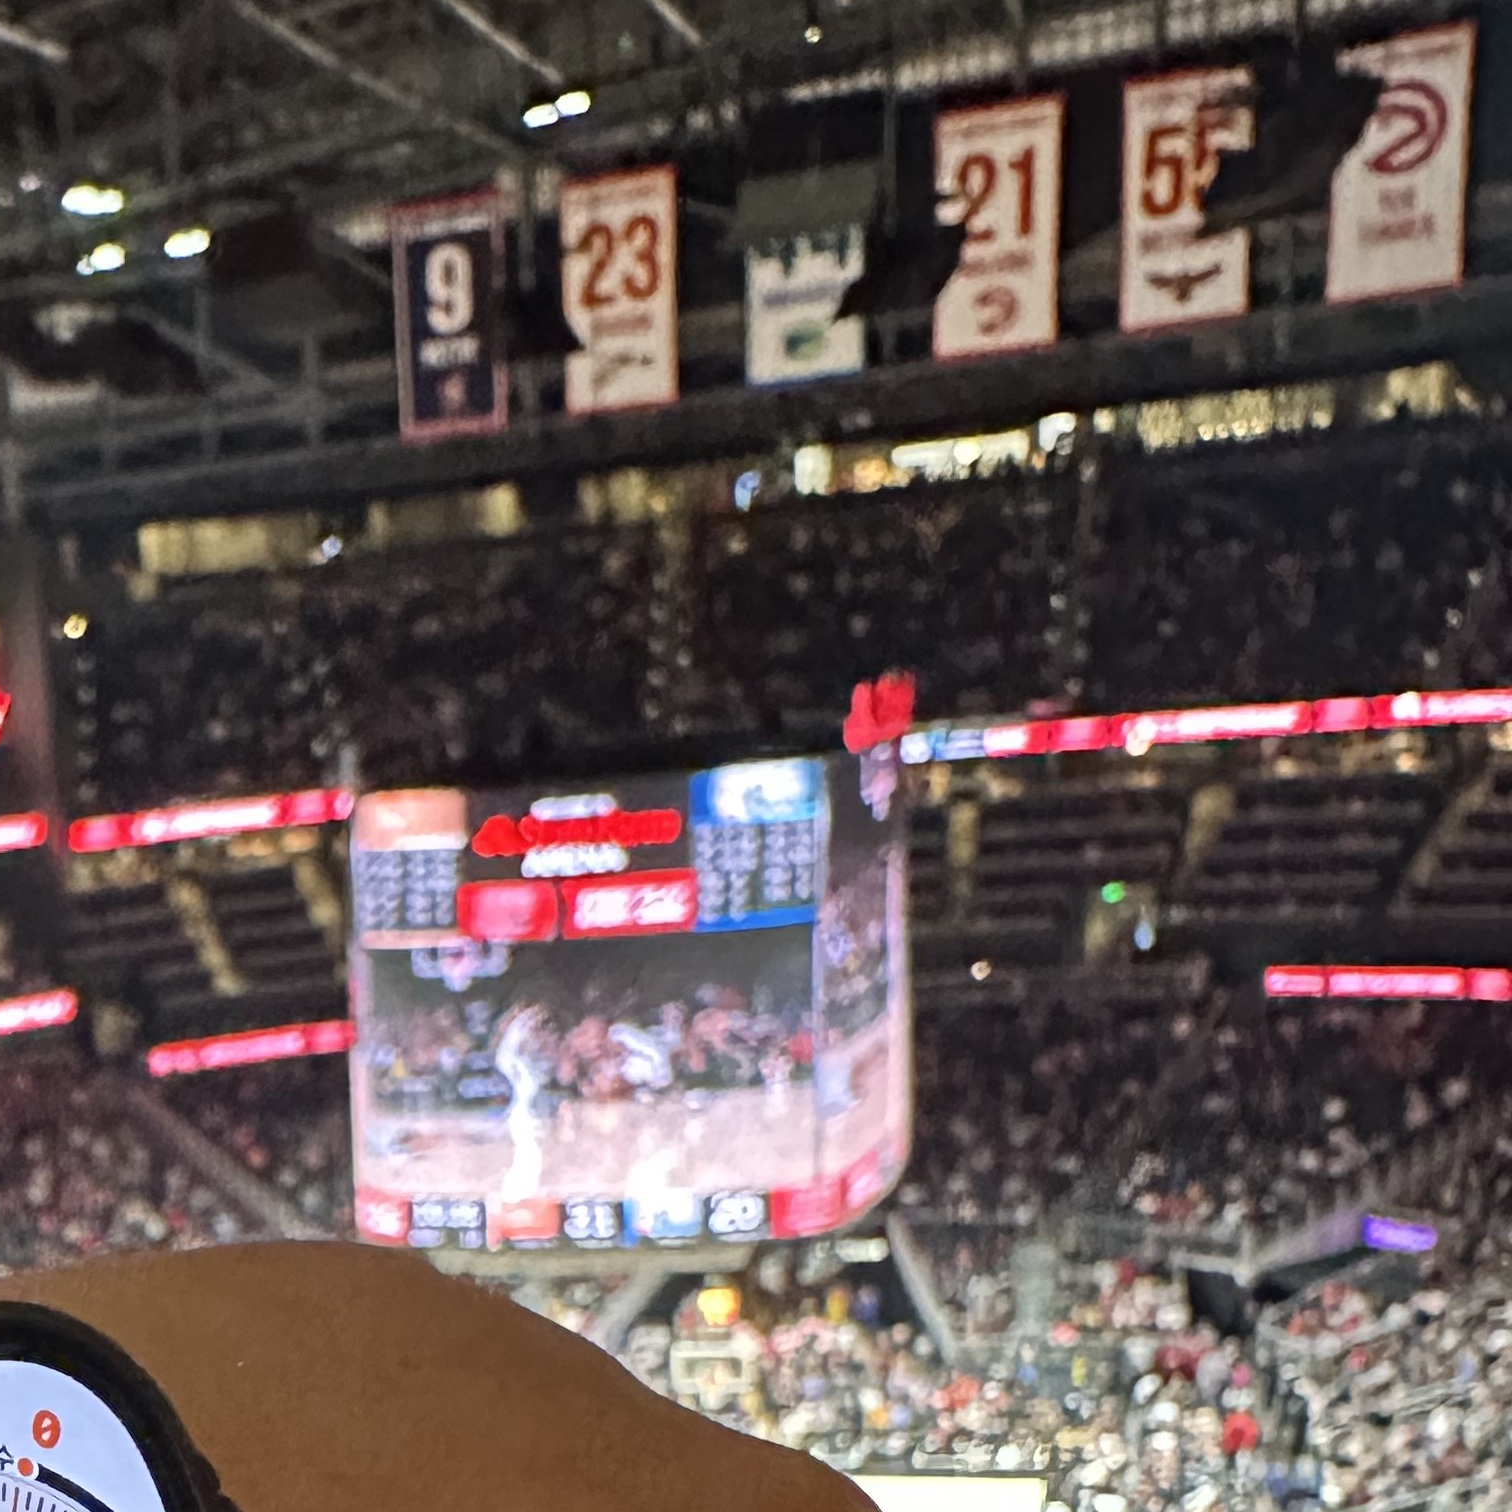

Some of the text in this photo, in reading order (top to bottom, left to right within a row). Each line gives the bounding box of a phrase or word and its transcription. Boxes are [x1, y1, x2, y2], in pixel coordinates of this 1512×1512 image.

[959, 146, 1035, 242] 21
[425, 242, 475, 335] 9
[578, 215, 660, 308] 23
